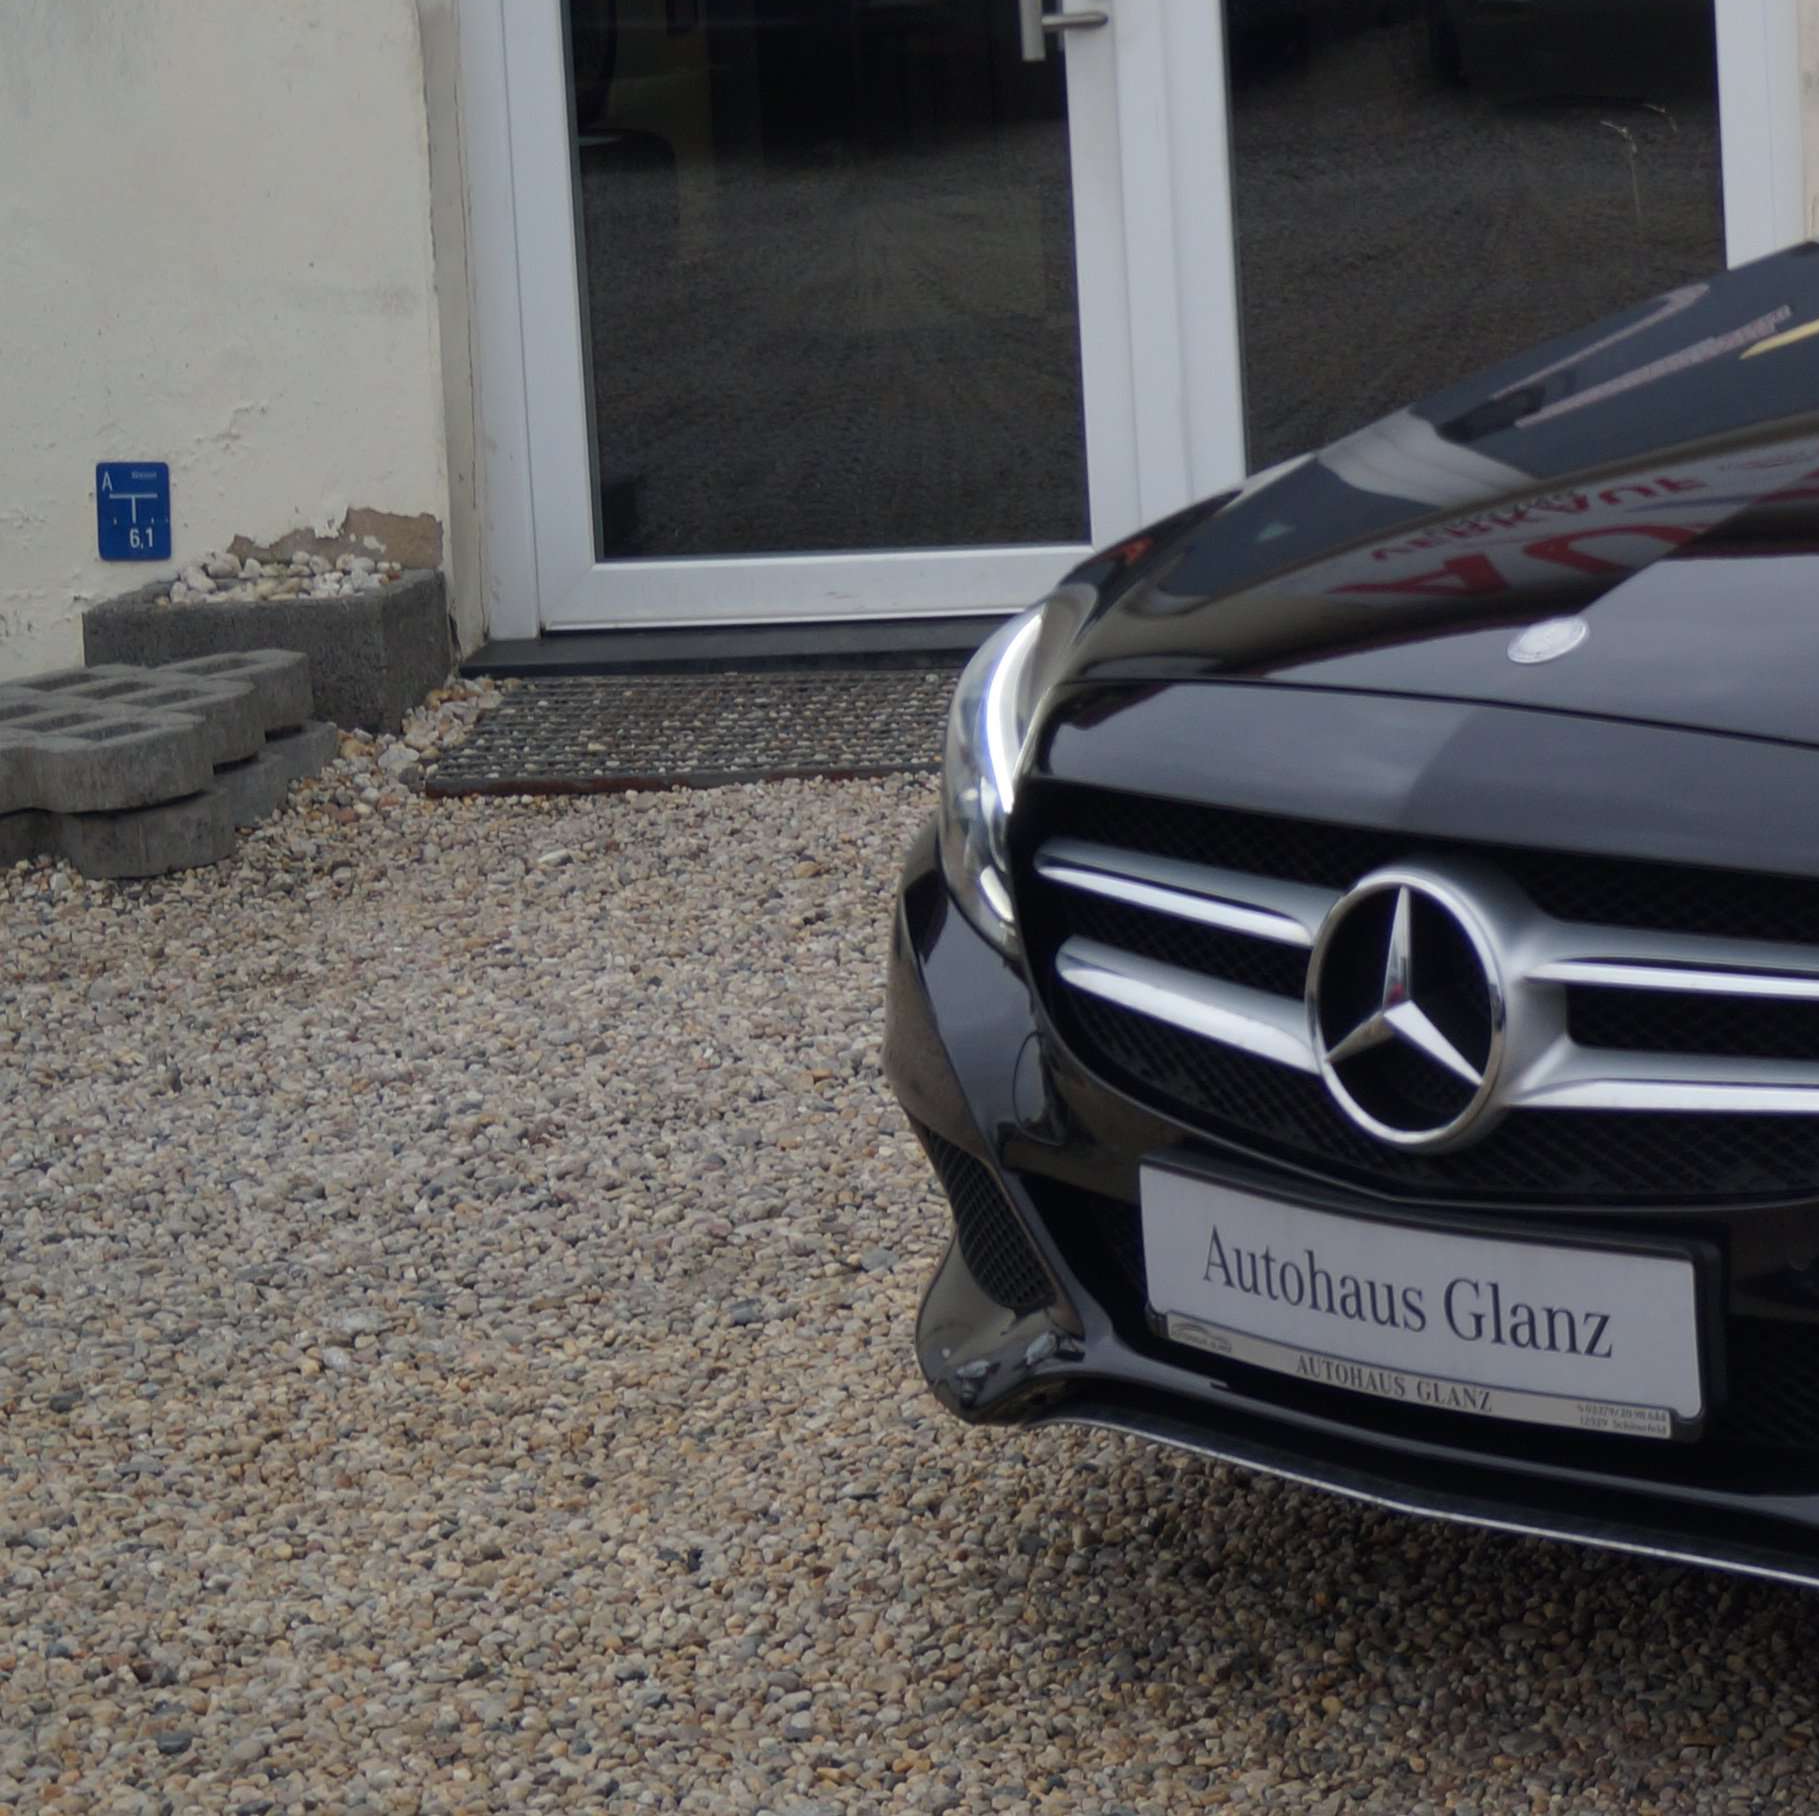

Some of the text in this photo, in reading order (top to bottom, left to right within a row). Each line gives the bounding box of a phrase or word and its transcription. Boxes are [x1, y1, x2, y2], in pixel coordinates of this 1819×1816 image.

[101, 471, 113, 492] A
[129, 527, 154, 550] 6,1
[1202, 1223, 1616, 1360] Autohaus Glanz
[1295, 1353, 1494, 1414] AUTOHAUS GLANZ
